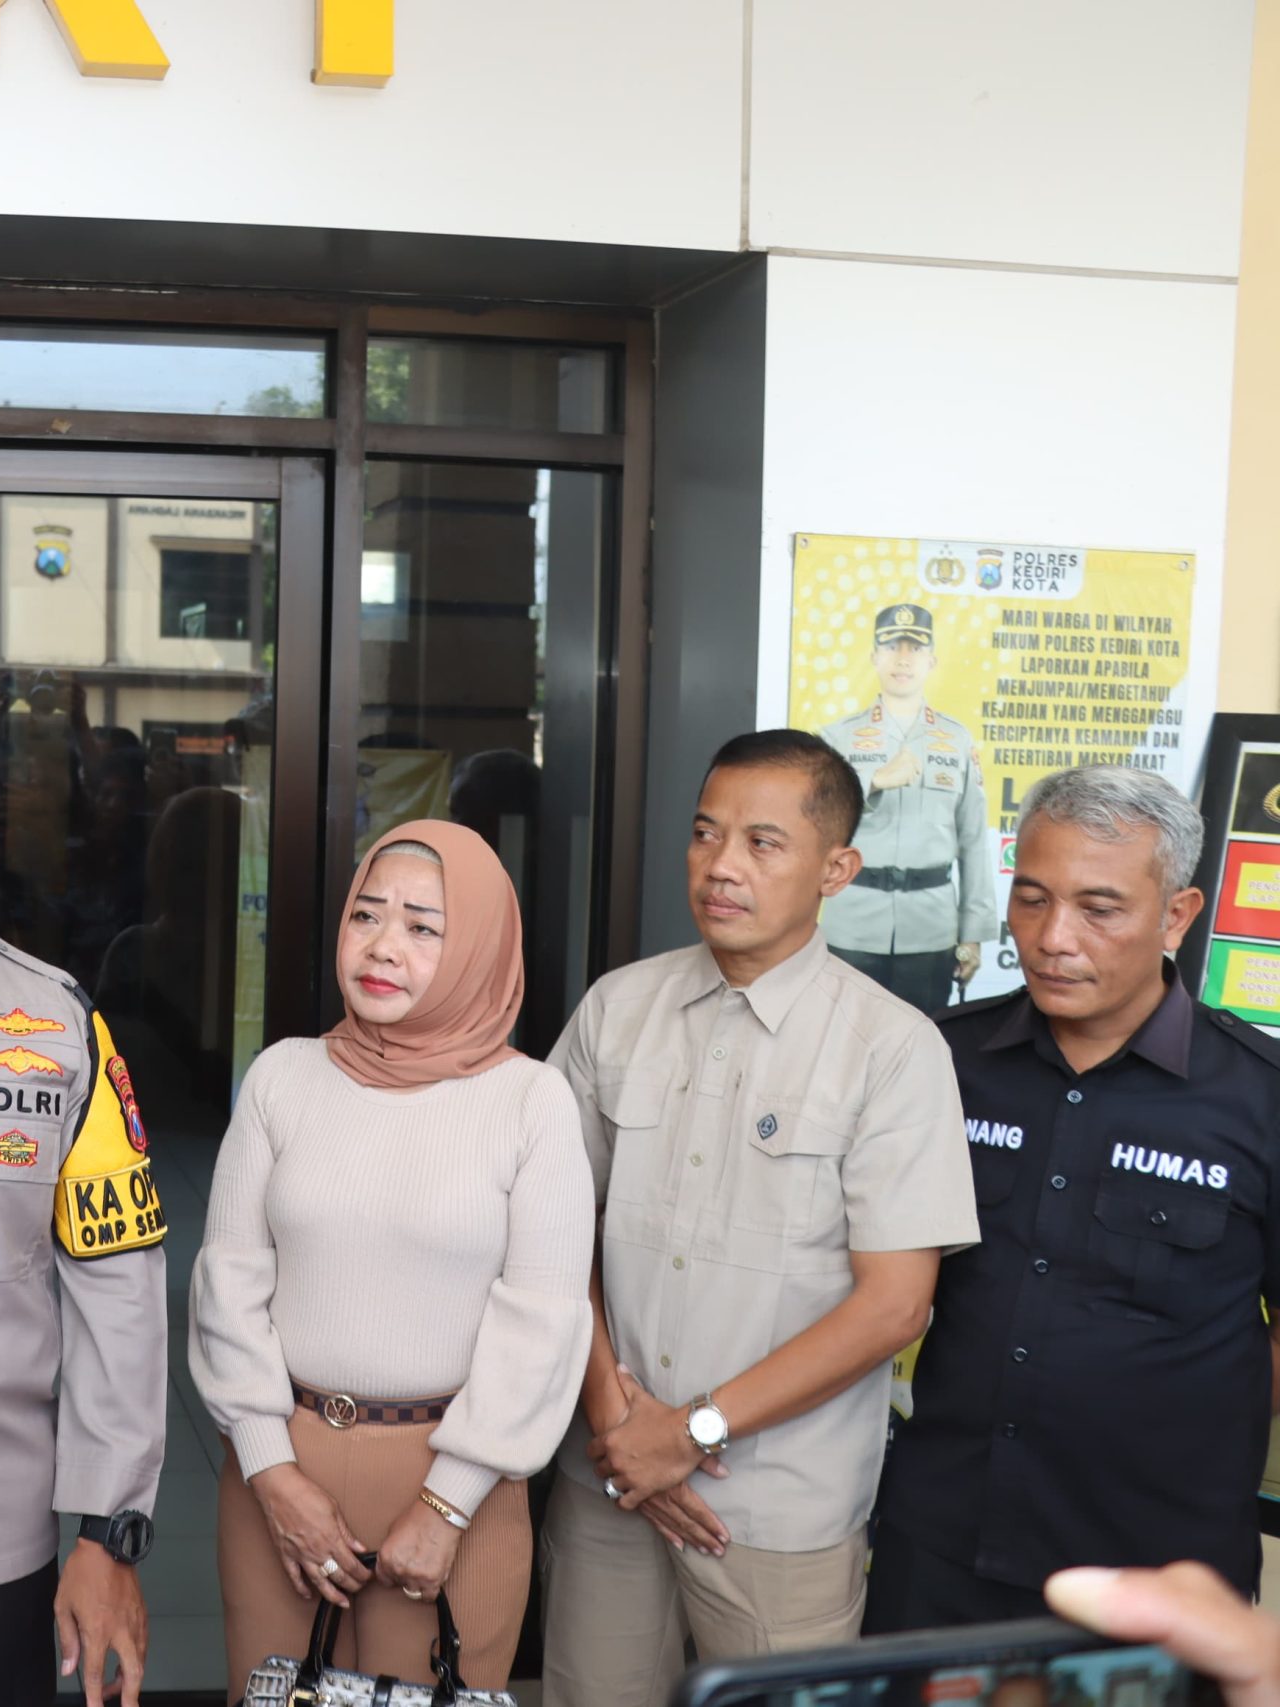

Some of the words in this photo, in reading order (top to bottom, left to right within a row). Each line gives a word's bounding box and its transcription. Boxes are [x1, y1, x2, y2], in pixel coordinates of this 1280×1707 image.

[1013, 551, 1078, 567] POLRES
[1013, 565, 1066, 579] KEDIRI
[1012, 578, 1060, 592] KOTA
[1002, 609, 1038, 628] MARI
[1043, 611, 1091, 630] WARGA
[1096, 614, 1109, 631] DI
[1113, 615, 1173, 635] WILAYAH
[992, 631, 1040, 650] HUKUM
[1045, 634, 1096, 653] POLRES
[1100, 637, 1143, 656] KEDIRI
[1147, 640, 1180, 658] KOTA
[1021, 656, 1090, 677] LAPORKAN
[1094, 659, 1150, 679] APABILA
[997, 678, 1171, 702] MENJUMPAI/MENGETAHUI
[982, 701, 1048, 721] KEJADIAN
[1053, 704, 1087, 722] YANG
[1091, 705, 1183, 726] MENGGANGGU
[982, 724, 1070, 745] TERCIPTANYA
[1075, 728, 1148, 748] KEAMANAN
[1153, 731, 1180, 748] DAN
[994, 747, 1073, 767] KETERTIBAN
[1078, 750, 1167, 771] MASYARAKAT
[1110, 1142, 1229, 1189] HUMAS
[74, 1177, 124, 1222] KA
[81, 1218, 127, 1248] OMP
